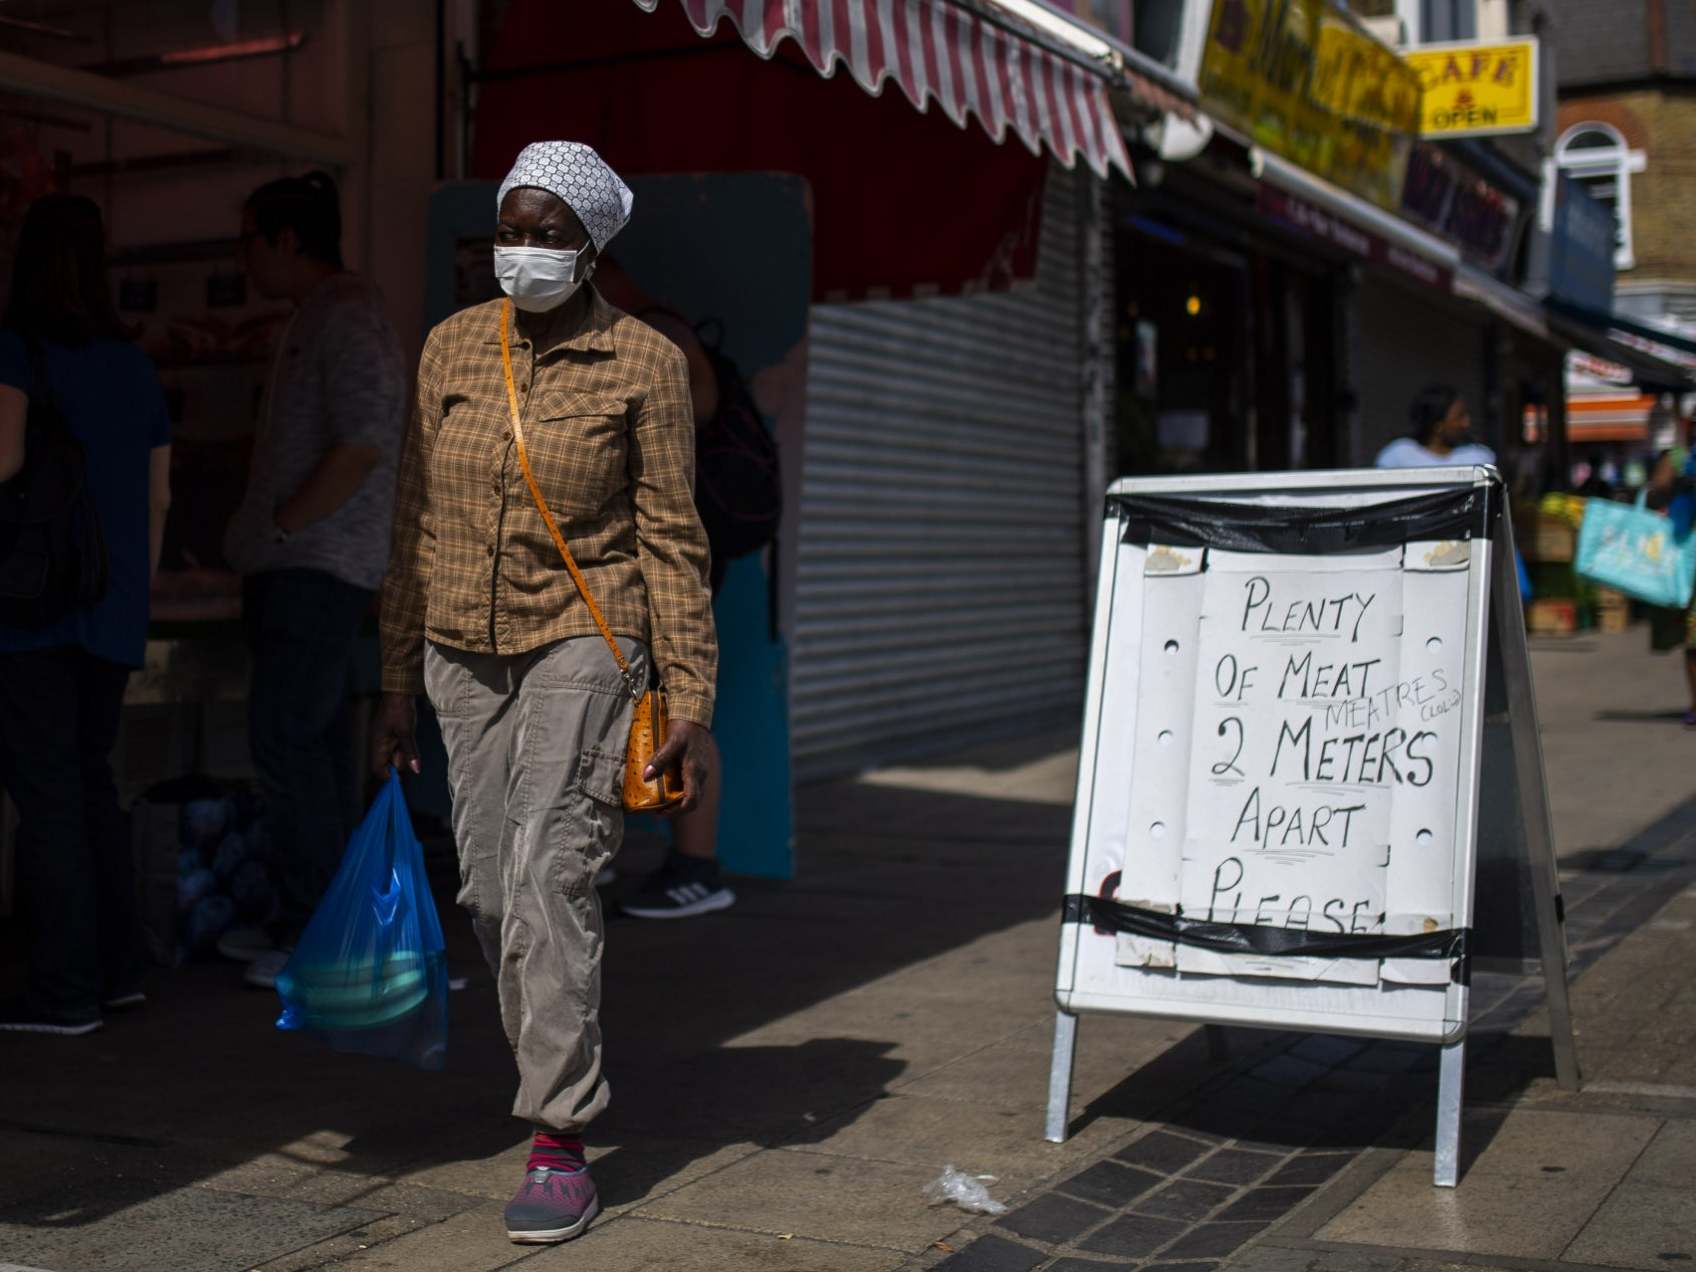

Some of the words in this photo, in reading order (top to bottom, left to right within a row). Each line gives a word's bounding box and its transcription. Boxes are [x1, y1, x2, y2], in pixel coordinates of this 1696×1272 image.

[1433, 107, 1498, 129] OPEN
[1241, 576, 1376, 643] PLENTY
[1215, 653, 1258, 700] OF
[1277, 651, 1381, 699] MEAT
[1325, 668, 1448, 731] MEATRES
[1211, 716, 1245, 777] 2
[1270, 715, 1438, 786] METERS
[1231, 786, 1367, 849] APART
